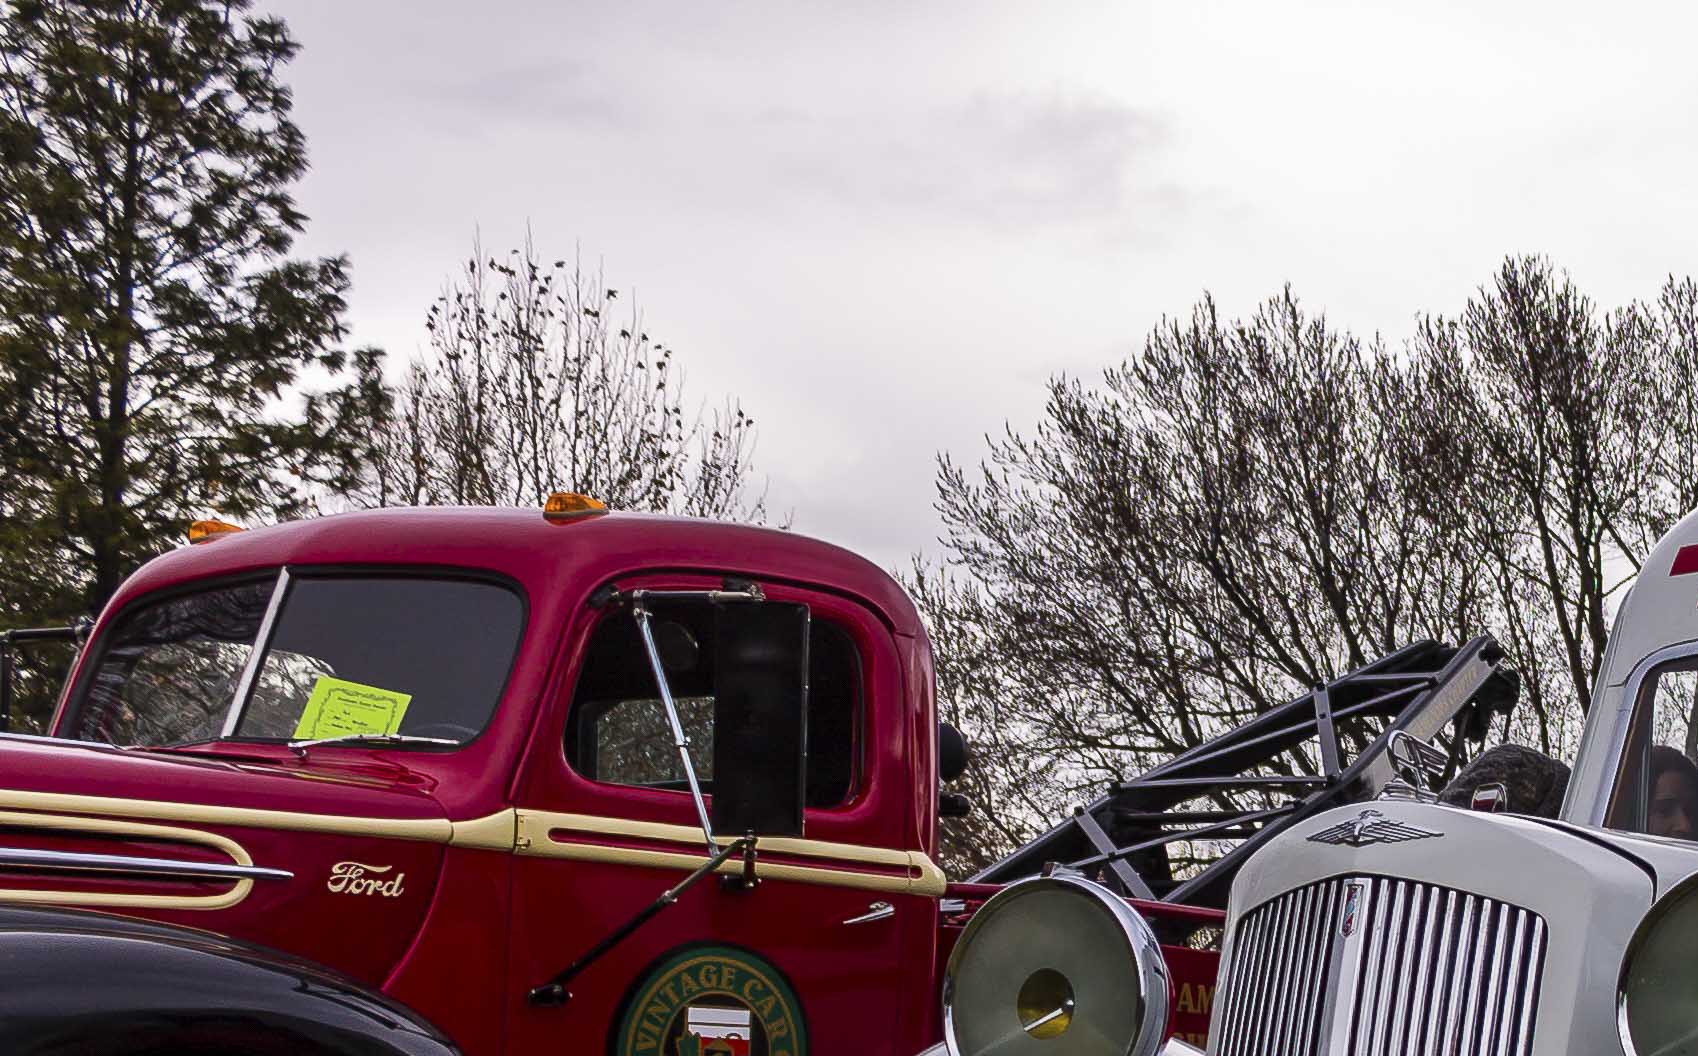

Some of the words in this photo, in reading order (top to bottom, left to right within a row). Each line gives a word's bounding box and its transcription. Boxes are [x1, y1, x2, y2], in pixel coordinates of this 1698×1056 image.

[327, 861, 405, 897] Ford
[635, 964, 736, 1053] VINTAGE
[743, 978, 788, 1038] CAR
